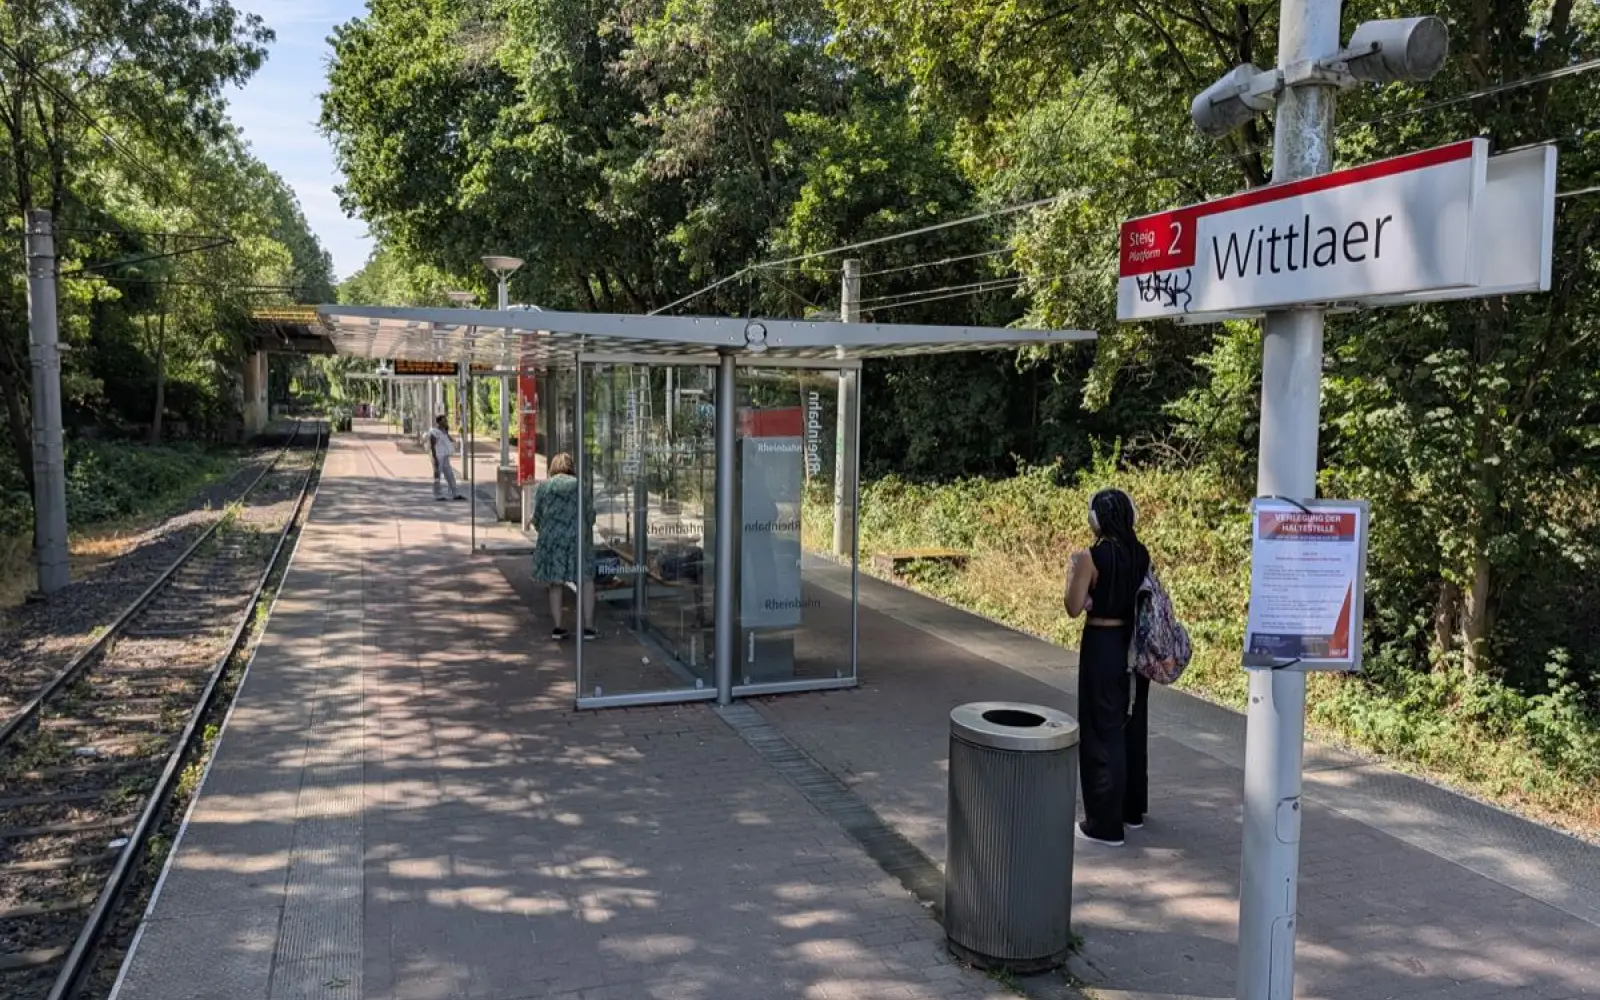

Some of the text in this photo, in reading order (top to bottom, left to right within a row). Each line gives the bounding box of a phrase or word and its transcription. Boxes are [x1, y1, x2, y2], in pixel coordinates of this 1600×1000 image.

[1129, 229, 1155, 248] Steig
[1167, 221, 1182, 255] 2
[1212, 213, 1393, 280] Wittlaer
[1128, 248, 1161, 263] Platform
[758, 443, 803, 452] Rheinbahn
[1282, 524, 1335, 532] HALTESTELLE
[765, 597, 821, 610] Rheinbahn
